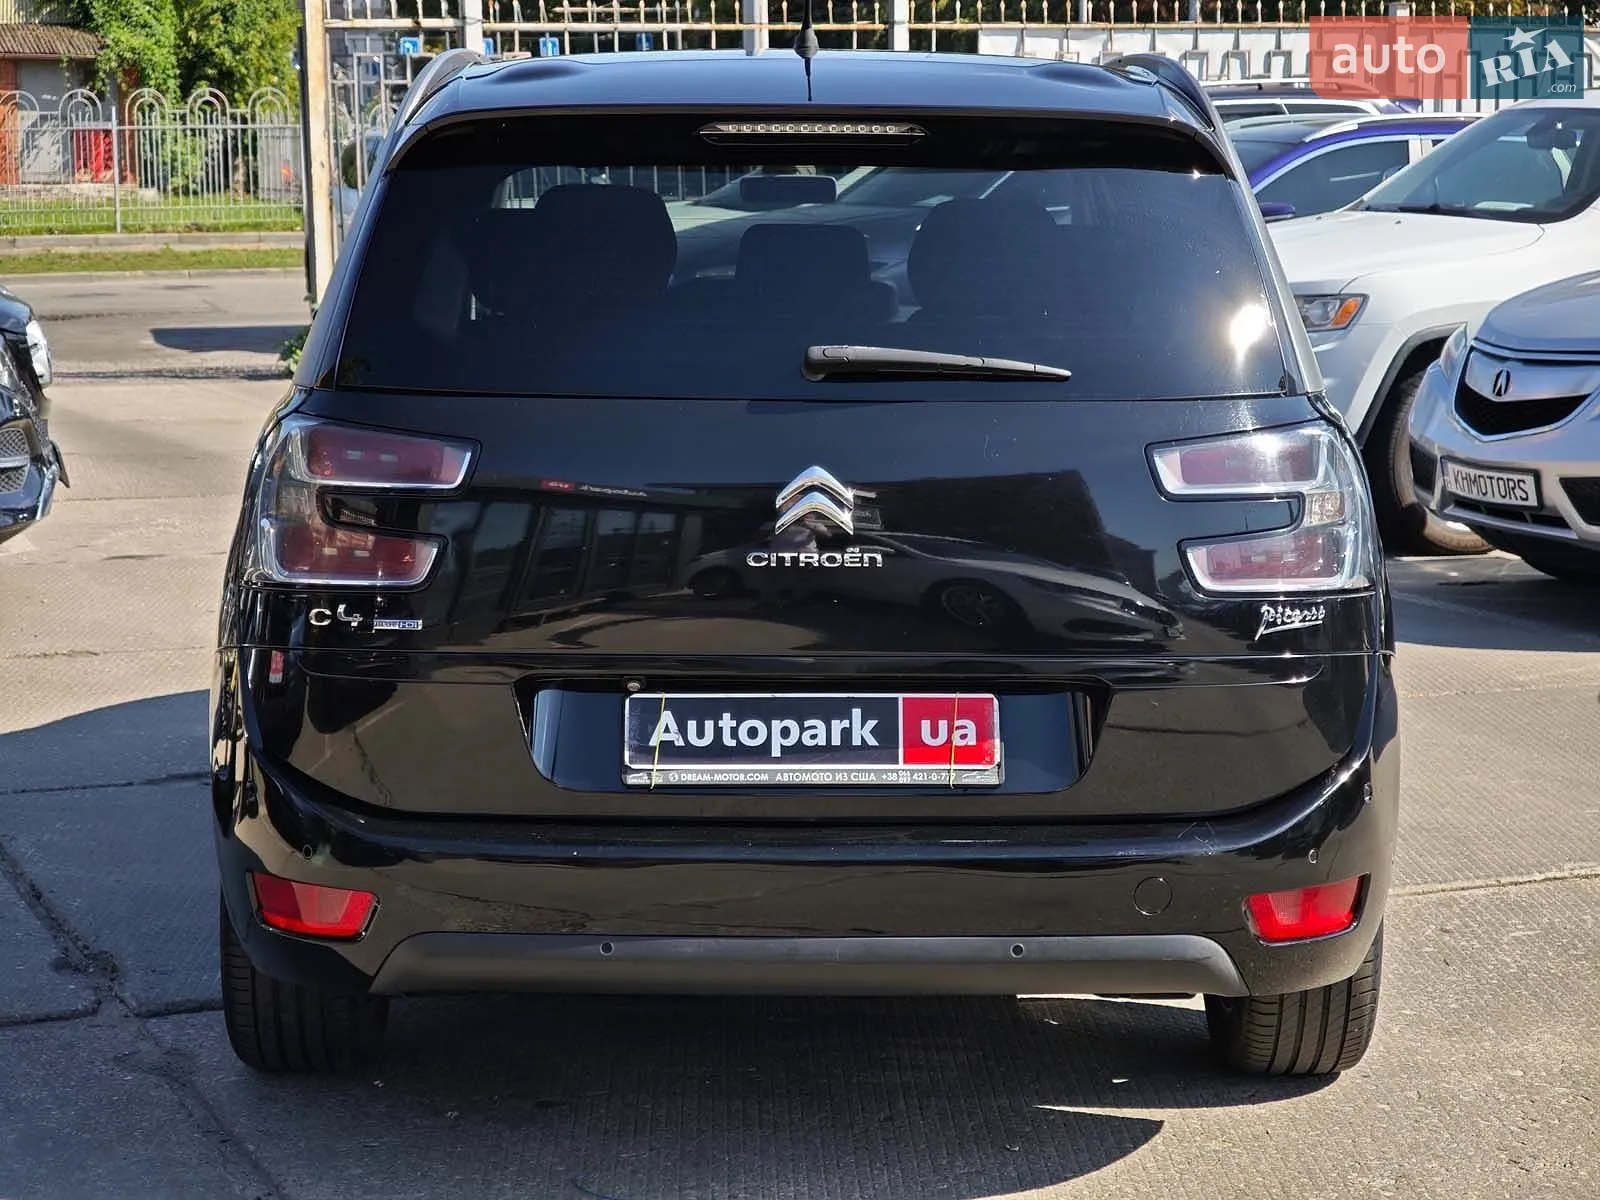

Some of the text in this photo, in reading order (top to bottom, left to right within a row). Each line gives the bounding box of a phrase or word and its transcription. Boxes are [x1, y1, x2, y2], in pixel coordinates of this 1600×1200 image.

[1452, 467, 1529, 502] KHMOTORS
[648, 708, 880, 758] Autopark
[919, 718, 977, 747] ua
[680, 772, 769, 782] DREAM-MOTOR.COM
[775, 771, 877, 782] АВТОМОТО ИЗ США
